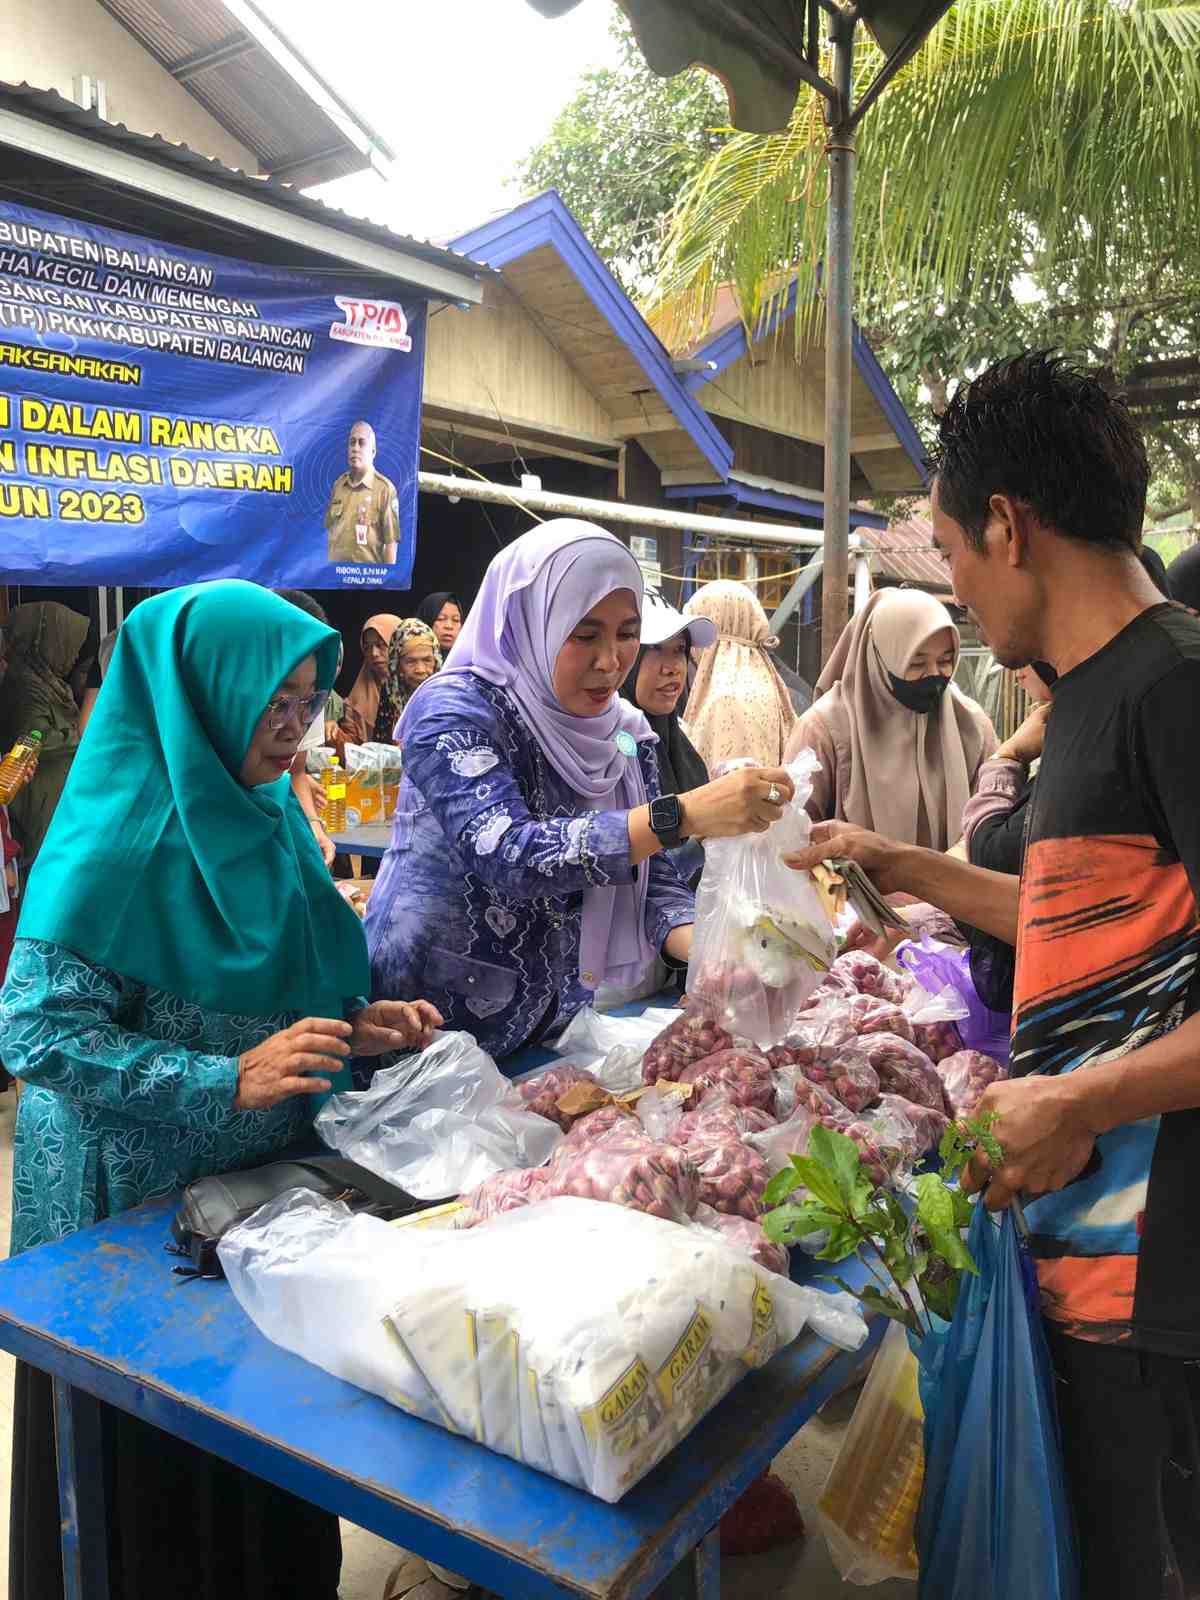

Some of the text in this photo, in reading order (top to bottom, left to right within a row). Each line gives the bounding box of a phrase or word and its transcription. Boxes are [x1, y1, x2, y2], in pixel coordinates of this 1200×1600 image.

[0, 222, 213, 287] BUPATEN BALANGAN
[36, 260, 99, 290] KECIL
[104, 275, 146, 299] DAN
[151, 285, 259, 318] MENENGAH
[47, 311, 96, 338] PKK
[100, 321, 215, 358] KABUPATEN
[219, 344, 305, 374] BALANGAN
[97, 299, 219, 333] KABUPATEN
[221, 319, 313, 350] BALANGAN
[0, 345, 140, 383] AKSANAKAN
[22, 399, 142, 444] DALAM
[150, 416, 281, 455] RANGKA
[27, 444, 163, 485] INFLASI
[170, 458, 293, 493] DAERAH
[60, 490, 145, 524] 2023
